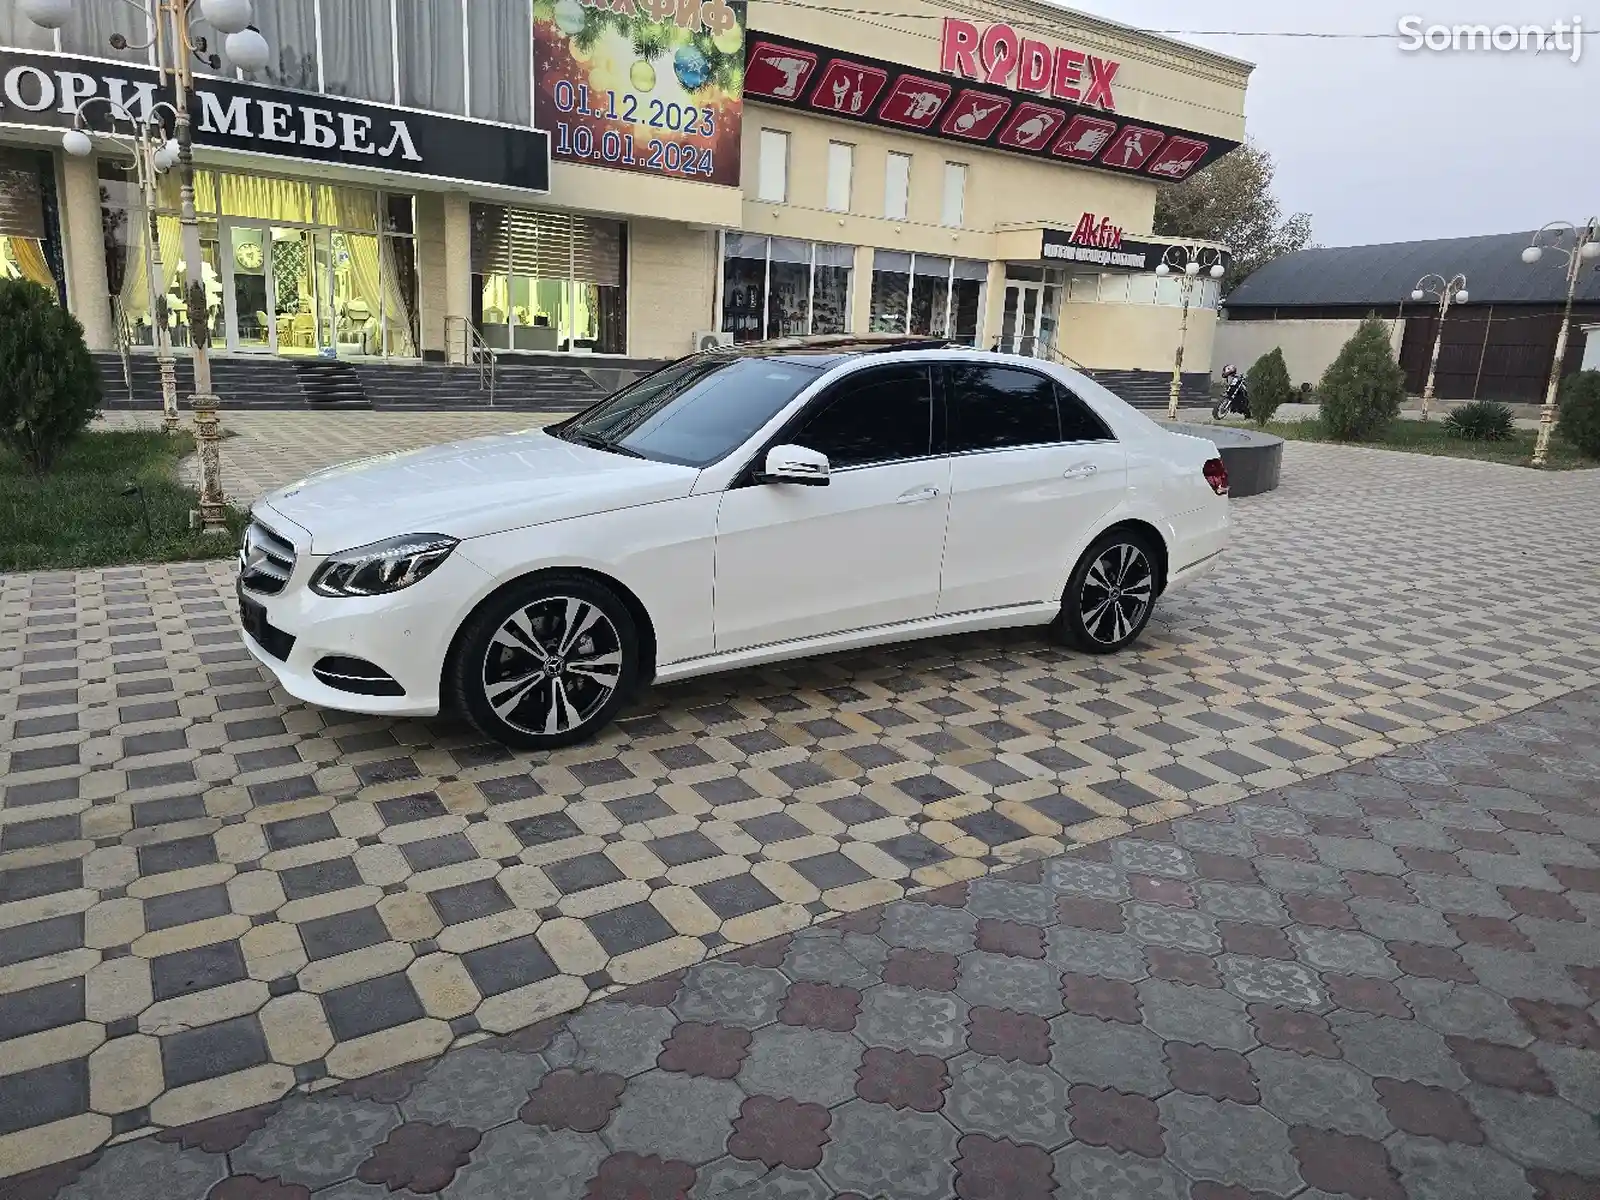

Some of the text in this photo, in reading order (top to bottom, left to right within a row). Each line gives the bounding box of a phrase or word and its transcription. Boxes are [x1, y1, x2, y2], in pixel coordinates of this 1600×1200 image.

[941, 17, 1120, 110] RODEX
[0, 66, 423, 162] ОРИ МЕБЕЛ
[554, 80, 715, 137] 01.12.2023
[556, 122, 714, 176] 10.01.2024
[1068, 211, 1122, 249] Akfix
